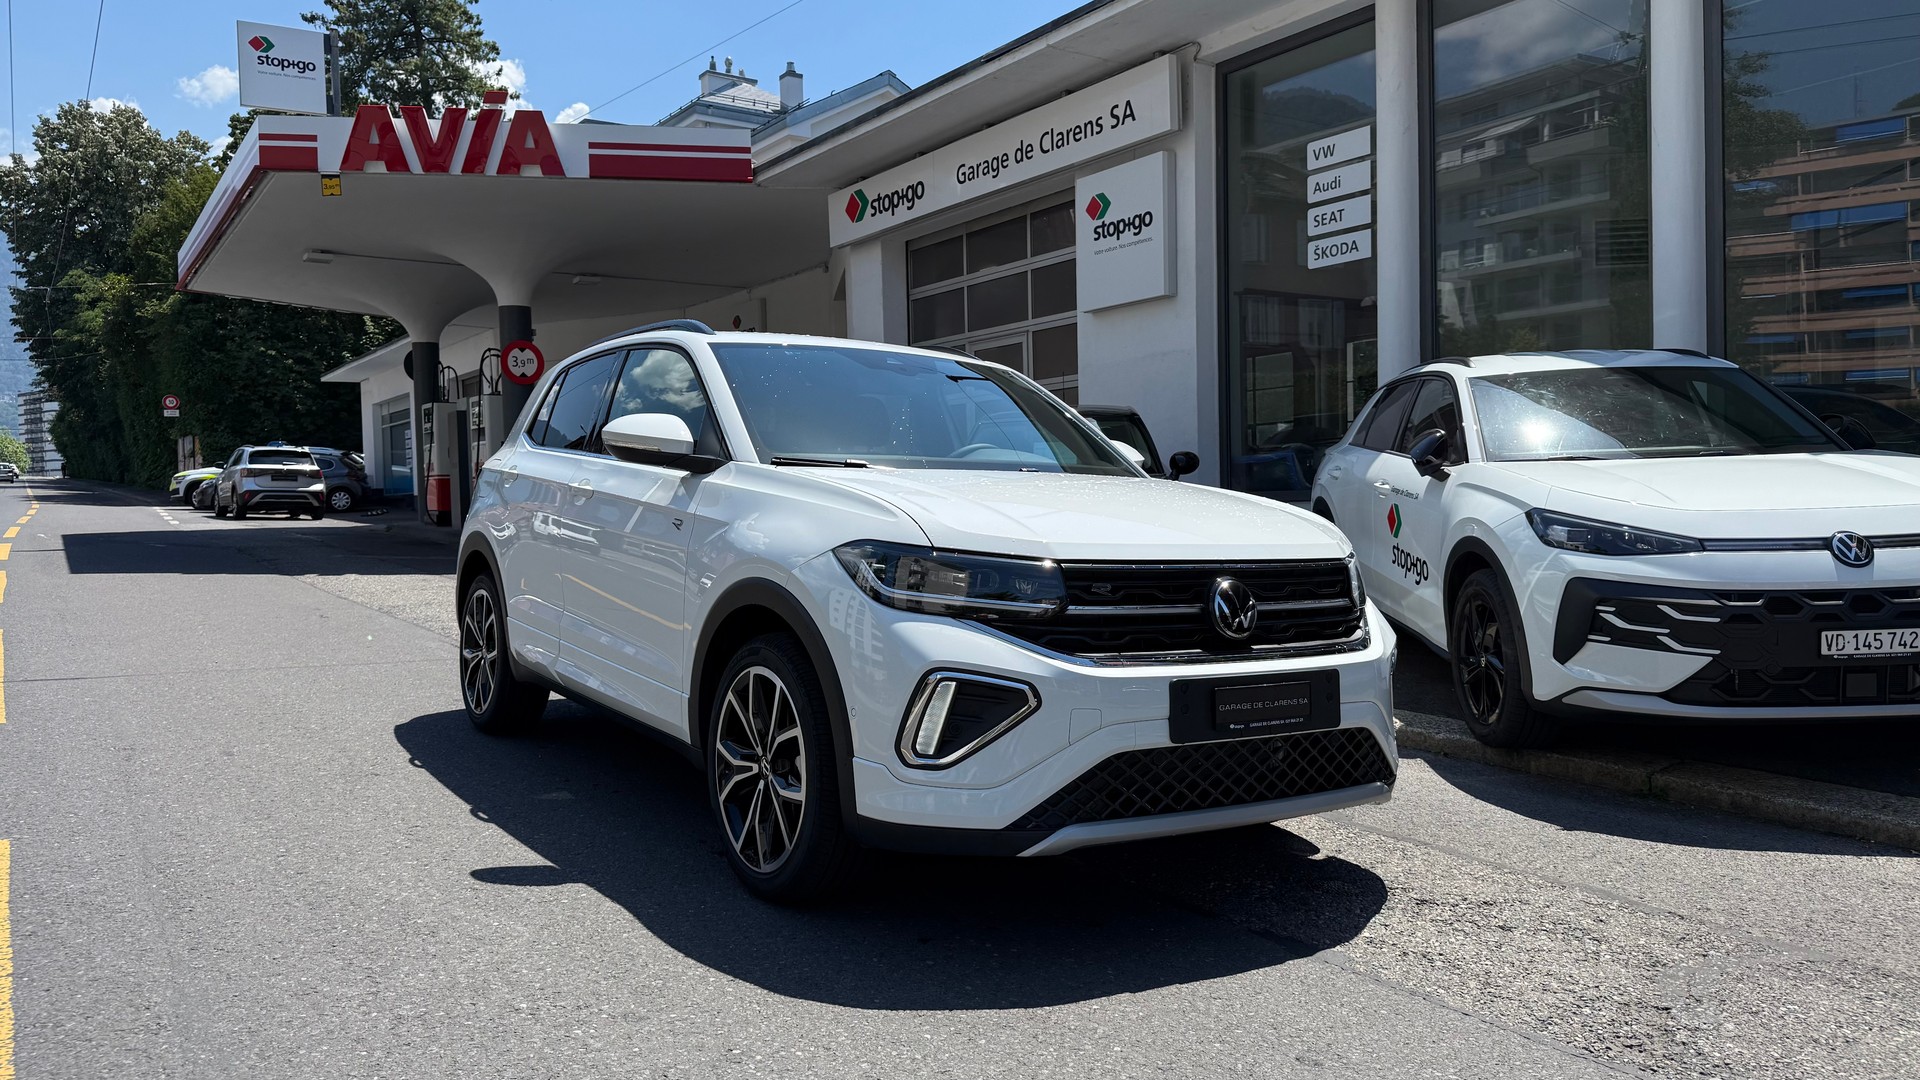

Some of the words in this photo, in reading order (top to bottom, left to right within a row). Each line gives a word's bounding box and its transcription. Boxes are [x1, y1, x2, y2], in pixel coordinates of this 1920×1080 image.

[257, 54, 316, 74] stop+go
[956, 153, 1009, 185] Garage
[1014, 139, 1034, 165] de
[1039, 115, 1103, 155] Clarens
[1109, 99, 1137, 130] SA
[1312, 143, 1336, 161] VW
[1312, 175, 1342, 195] Audi
[869, 180, 925, 218] stop+go
[1093, 210, 1154, 242] stop+go
[1313, 208, 1345, 228] SEAT
[1313, 240, 1360, 261] ŠKODA
[1391, 543, 1429, 586] stop+go
[1218, 702, 1252, 711] GARAGE
[1253, 701, 1263, 709] DE
[1264, 699, 1298, 708] CLARENS
[1298, 697, 1309, 705] SA
